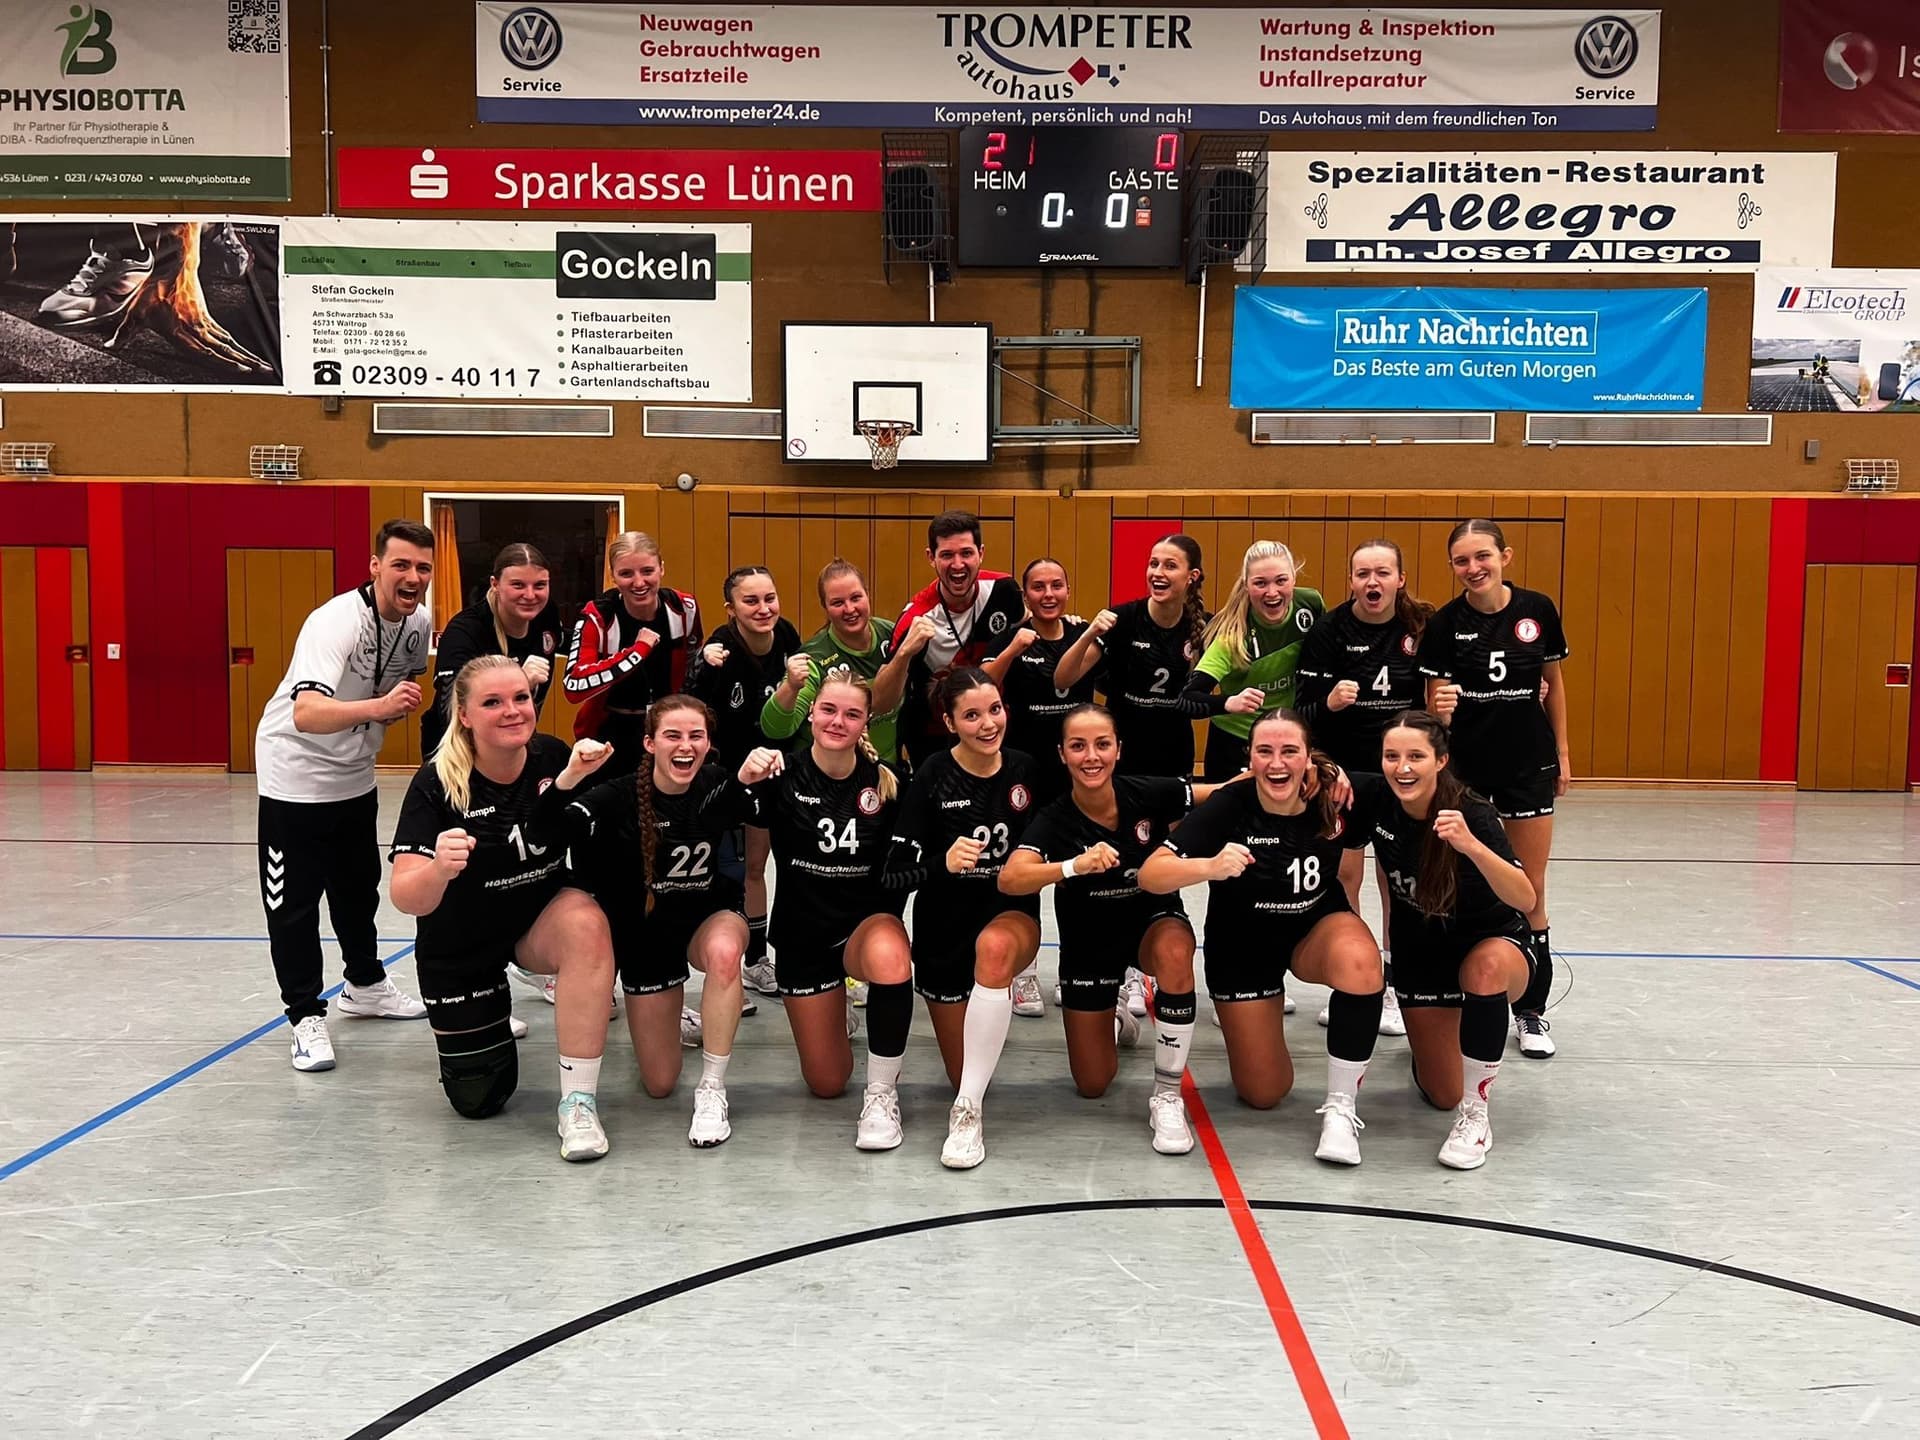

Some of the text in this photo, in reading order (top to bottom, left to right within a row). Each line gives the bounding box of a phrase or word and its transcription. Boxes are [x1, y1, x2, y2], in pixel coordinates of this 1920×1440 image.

[640, 14, 753, 34] Neuwagen
[937, 13, 1192, 49] TROMPETER
[1260, 19, 1496, 40] Wartung & Inspektion
[640, 40, 820, 60] Gebrauchtwagen
[1260, 45, 1422, 66] Instandsetzung
[503, 78, 562, 92] Service
[640, 66, 748, 84] Ersatzteile
[957, 50, 1074, 100] autohaus
[1260, 70, 1426, 92] Unfallreparatur
[0, 89, 185, 111] PHYSIOBOTTA
[1575, 86, 1635, 100] Service
[640, 104, 820, 122] www.trompeter24.de
[935, 107, 1192, 126] Kompetent, persönlich und nah!
[1260, 111, 1558, 126] Das Autohaus mit dem freundlichen Ton
[14, 122, 169, 133] Ihr Partner für Physiotherapie &
[36, 134, 148, 146] Radiofrequenztherapie
[151, 135, 160, 144] in
[163, 135, 194, 144] Lünen
[1154, 134, 1178, 169] 0
[22, 174, 48, 182] Lünen
[64, 174, 86, 182] 0231
[88, 174, 92, 182] /
[95, 174, 118, 182] 4743
[120, 174, 143, 182] 0760
[160, 174, 250, 184] www.physiobotta.de
[495, 164, 706, 208] Sparkasse
[728, 165, 852, 201] Lünen
[974, 171, 1026, 190] HEIM
[1109, 169, 1179, 190] GÄSTE
[1388, 192, 1676, 238] Allegro
[1335, 242, 1730, 262] Inh. Josef Allegro
[561, 249, 712, 280] Gockeln
[312, 284, 394, 296] Stefan Gockeln
[1803, 290, 1905, 310] Elcotech
[571, 312, 671, 323] Tiefbauarbeiten
[1854, 310, 1906, 320] GROUP
[571, 328, 673, 340] Pflasterarbeiten
[1342, 317, 1588, 348] Ruhr Nachrichten
[571, 344, 684, 356] Kanalbauarbeiten
[570, 360, 688, 373] Asphaltierarbeiten
[1333, 359, 1597, 382] Das Beste am Guten Morgen
[352, 366, 428, 385] 02309
[451, 368, 480, 386] 40
[490, 368, 514, 387] 11
[528, 368, 541, 388] 7
[570, 376, 710, 388] Gartenlandschaftsbau
[1593, 392, 1694, 400] www.RuhrNachrichten.de
[1488, 651, 1506, 682] 5
[1150, 668, 1170, 694] 2
[1372, 666, 1391, 696] 4
[464, 806, 496, 819] Kempa
[818, 818, 860, 854] 34
[973, 822, 1009, 860] 23
[1247, 836, 1280, 845] Kempa
[667, 842, 711, 878] 22
[1286, 856, 1320, 894] 18
